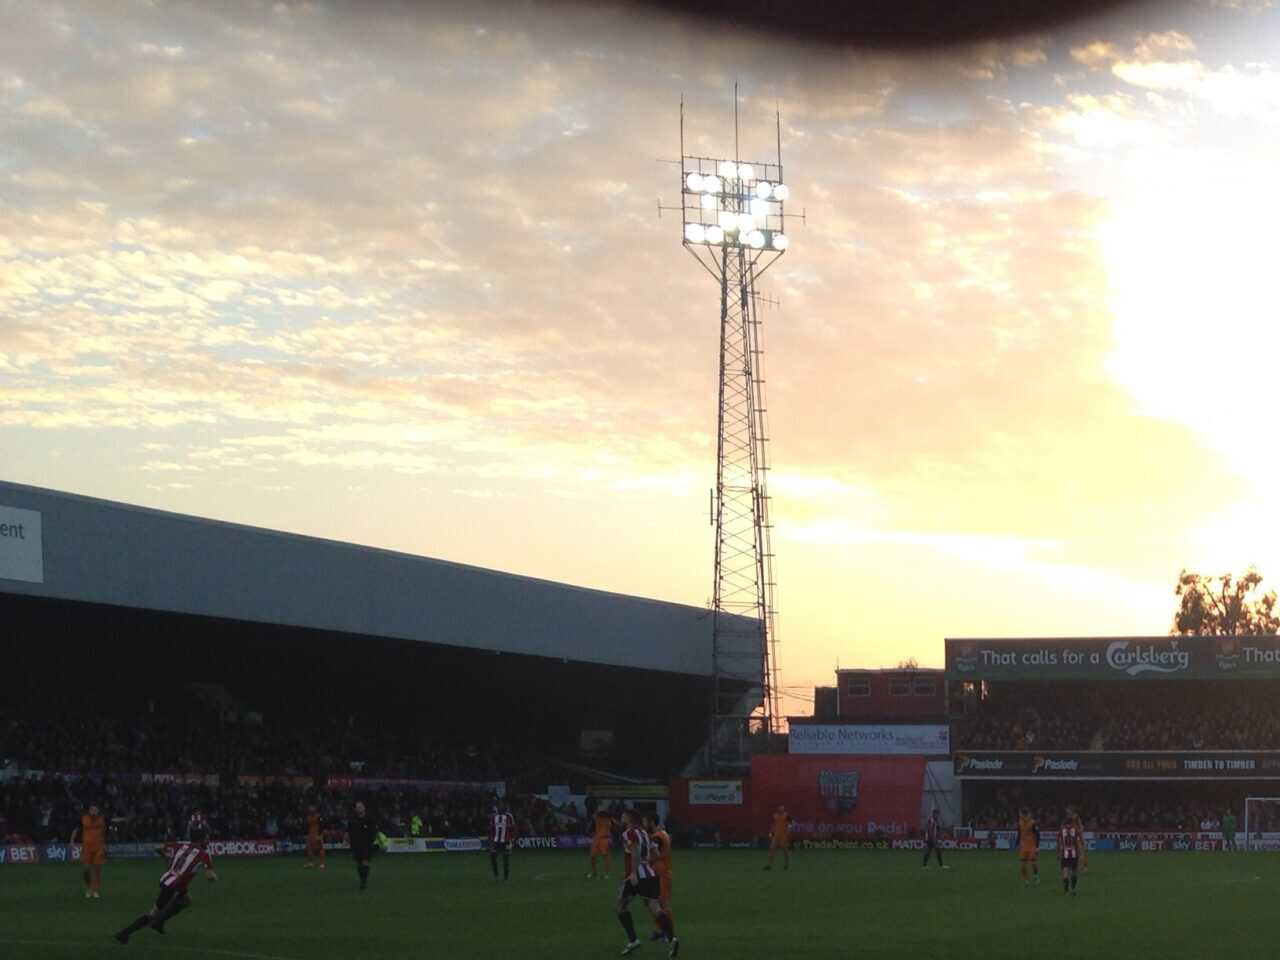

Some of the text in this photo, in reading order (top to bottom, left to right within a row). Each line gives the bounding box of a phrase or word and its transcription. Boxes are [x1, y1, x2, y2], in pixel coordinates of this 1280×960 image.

[980, 641, 1189, 672] That calls for a Carlsberg
[1243, 647, 1280, 662] That
[838, 728, 894, 740] Networks
[11, 845, 34, 862] BET
[46, 844, 66, 862] sky
